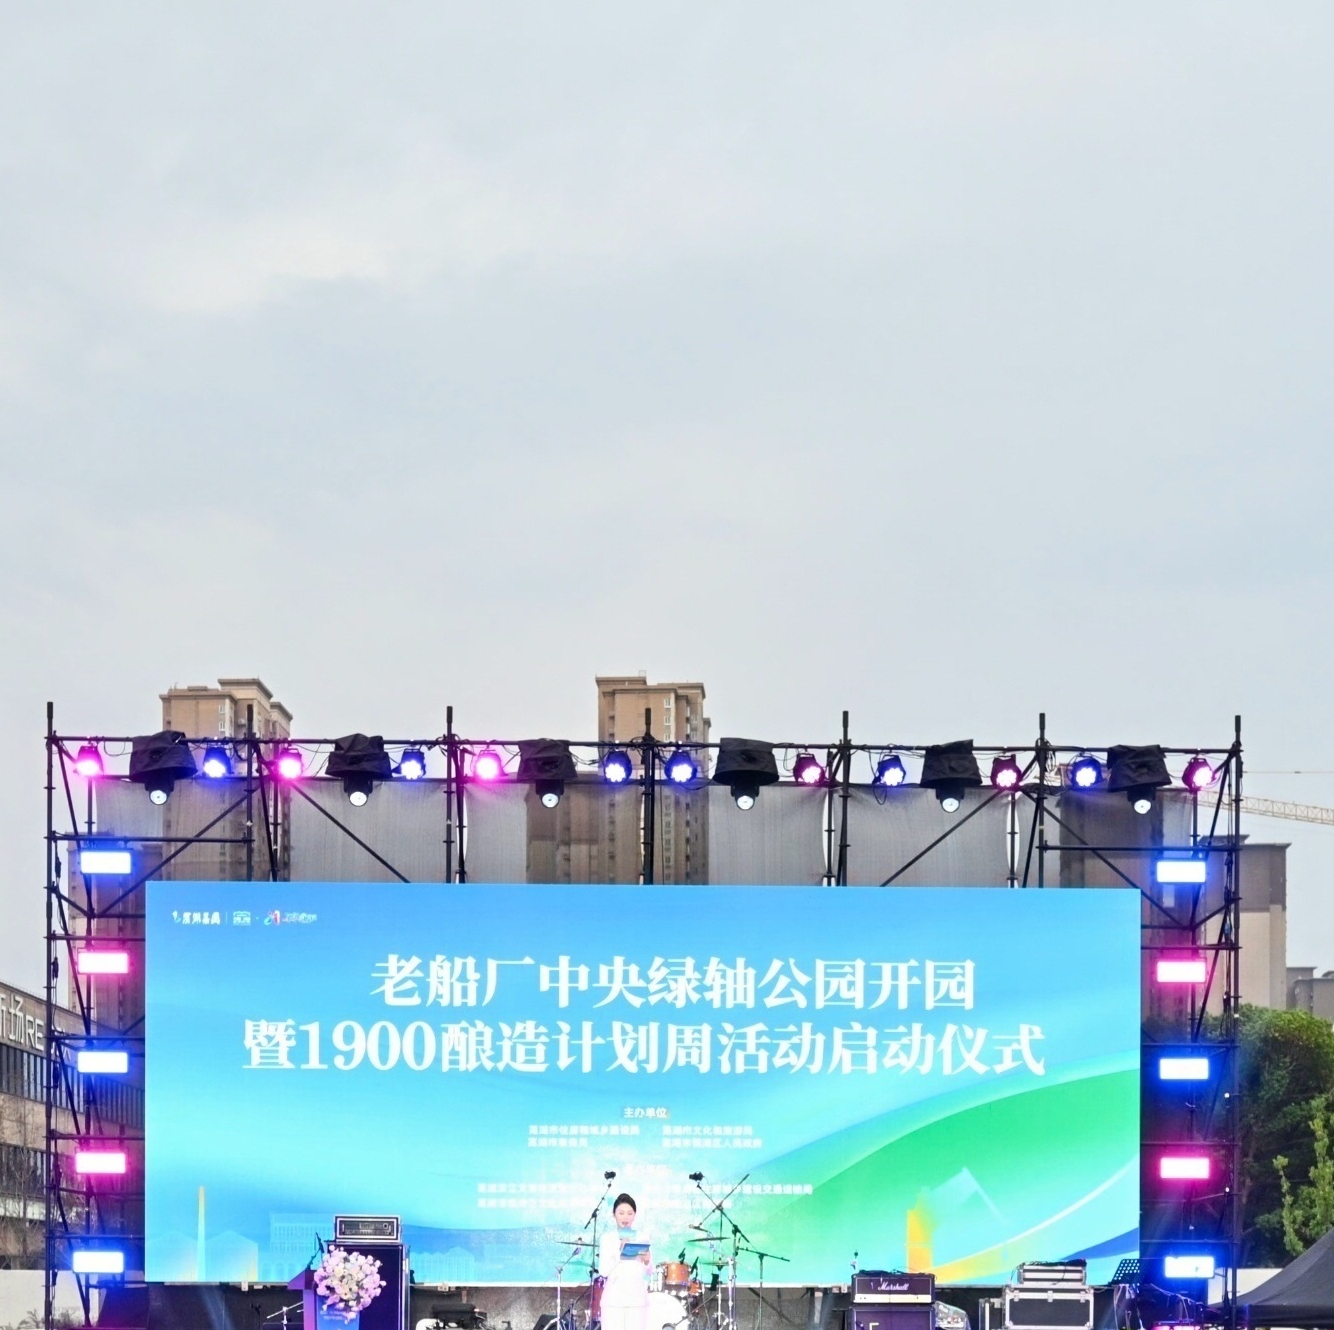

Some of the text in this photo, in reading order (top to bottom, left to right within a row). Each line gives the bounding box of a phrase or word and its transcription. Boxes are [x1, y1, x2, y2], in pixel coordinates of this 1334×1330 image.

[369, 955, 975, 1010] 老船厂中央绿轴公园开园
[242, 1020, 1046, 1075] 暨1900酿造计划周活动启动仪式
[624, 1107, 668, 1119] 主办单位
[878, 1281, 910, 1291] Marshall
